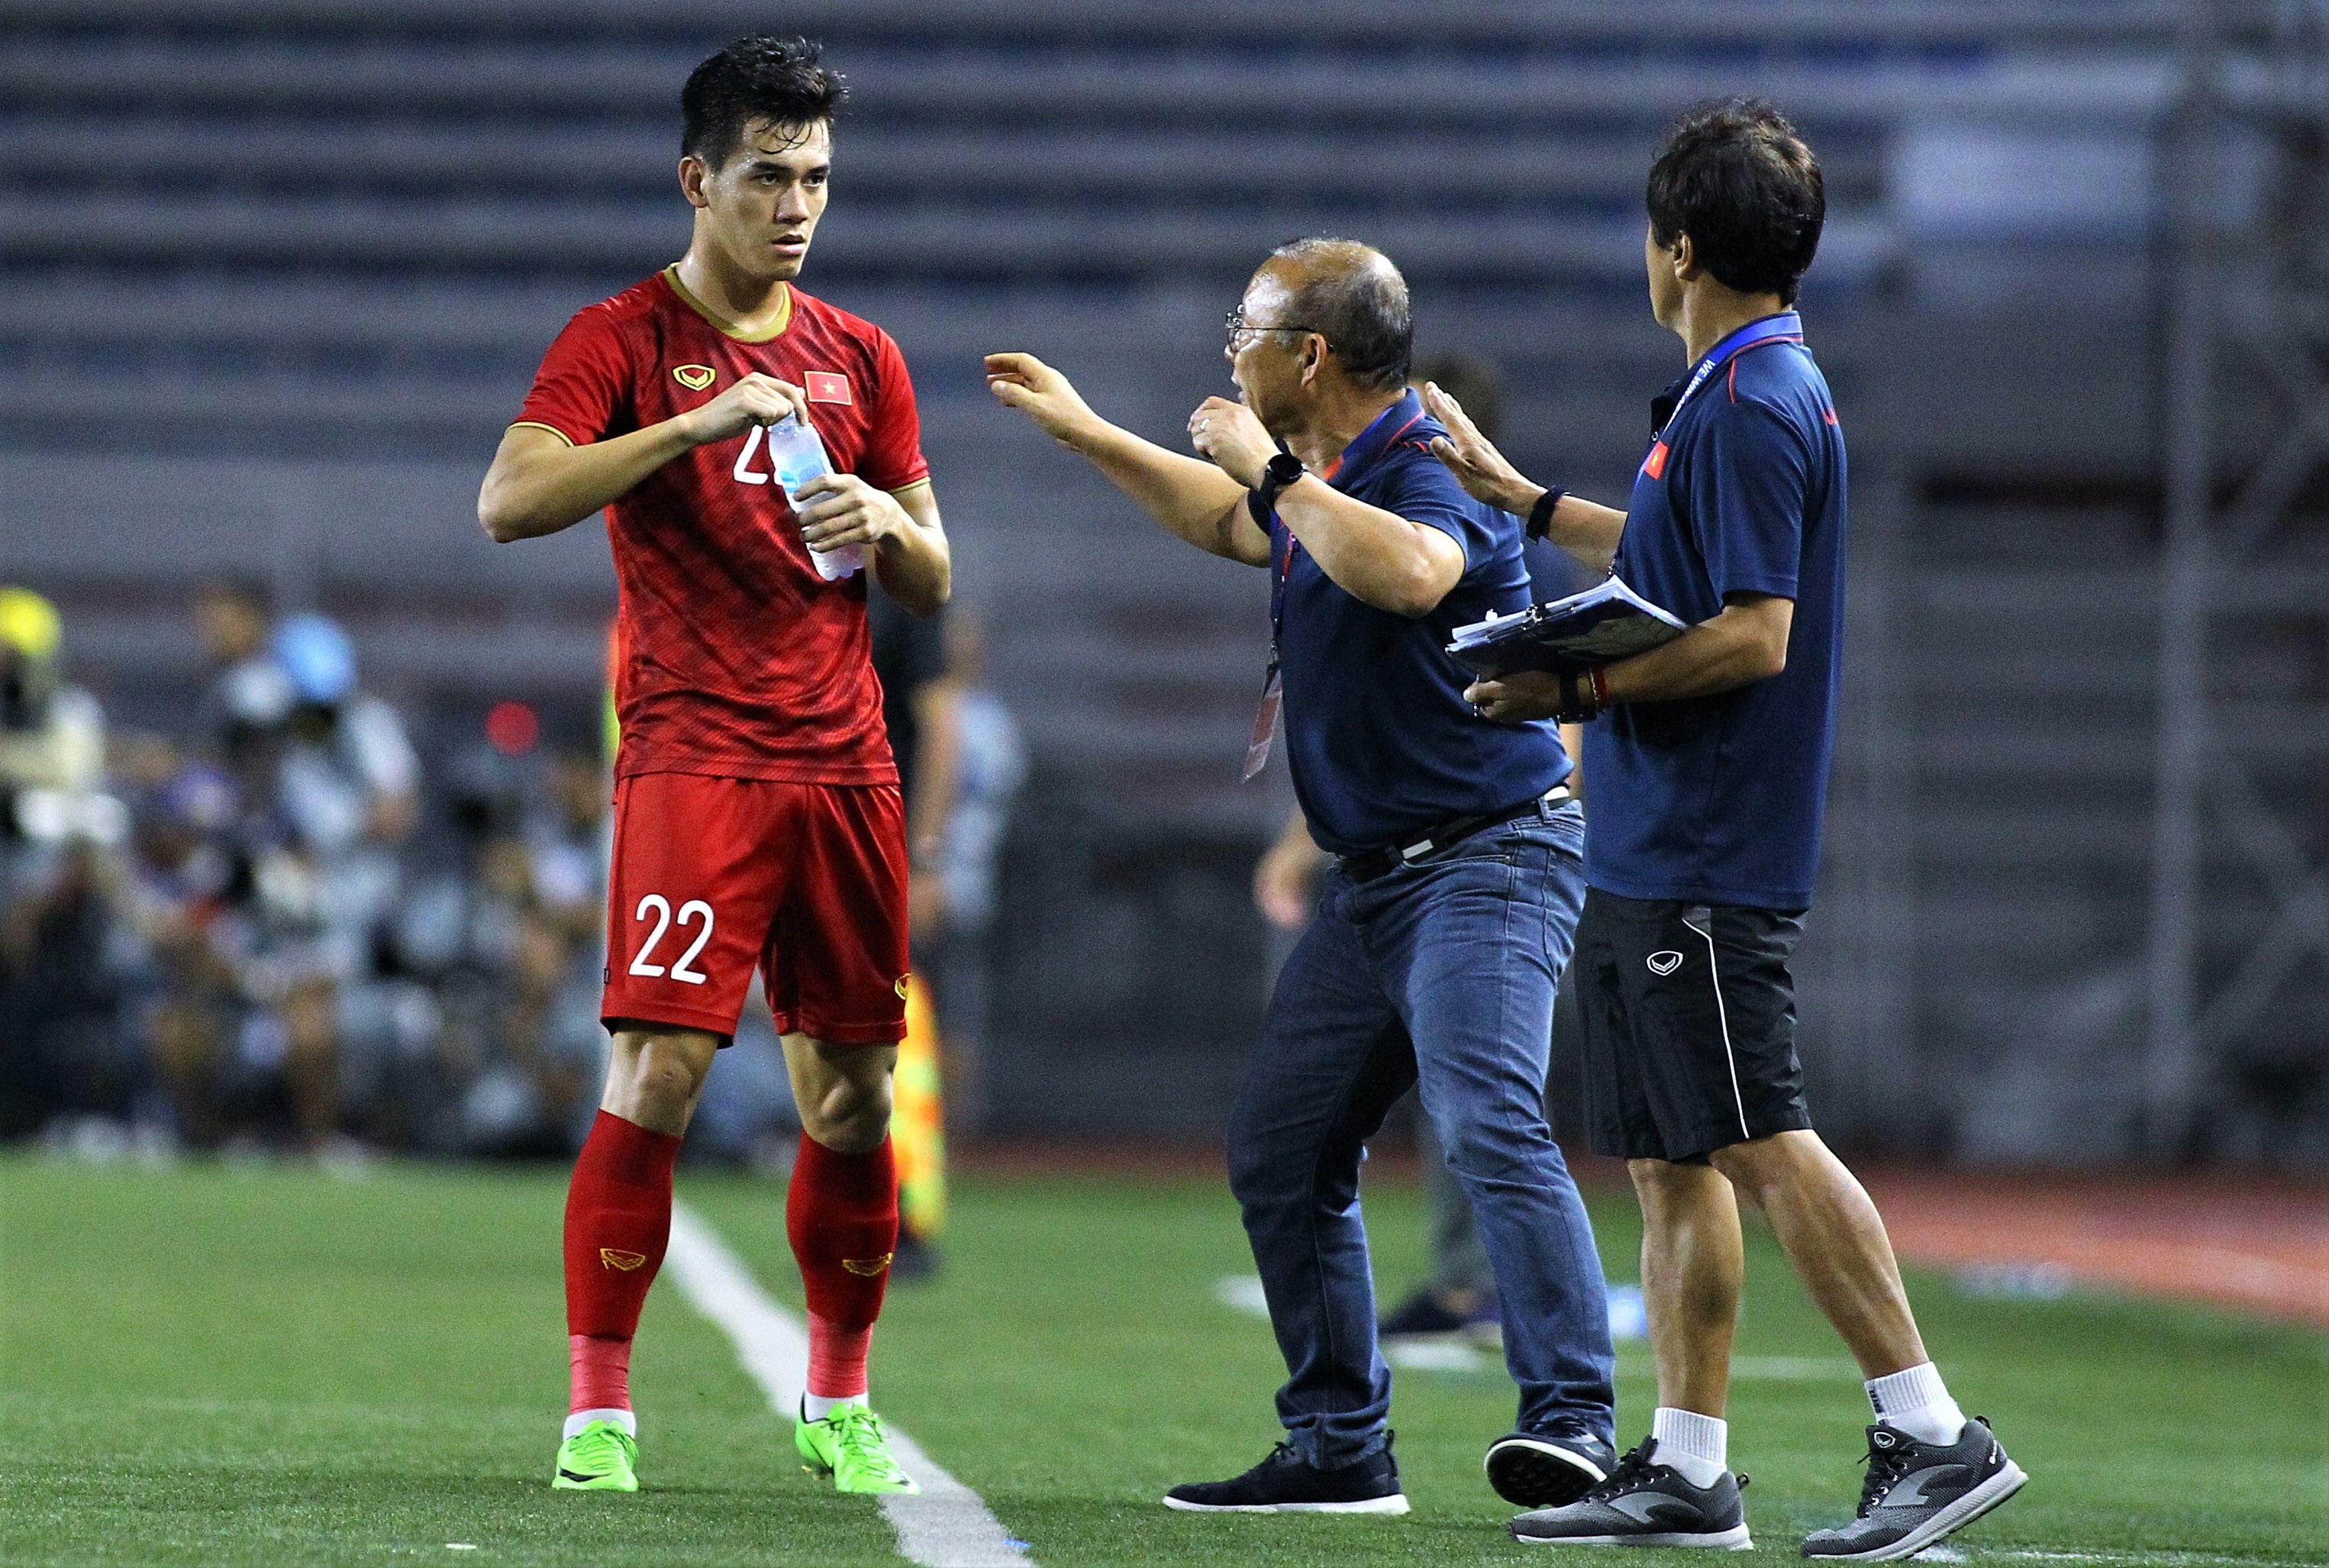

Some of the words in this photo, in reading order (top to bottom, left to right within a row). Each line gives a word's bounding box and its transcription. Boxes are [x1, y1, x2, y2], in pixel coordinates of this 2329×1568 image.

[1684, 375, 1703, 397] WIN
[1697, 359, 1716, 378] WE
[734, 424, 785, 486] 2
[628, 893, 715, 985] 22
